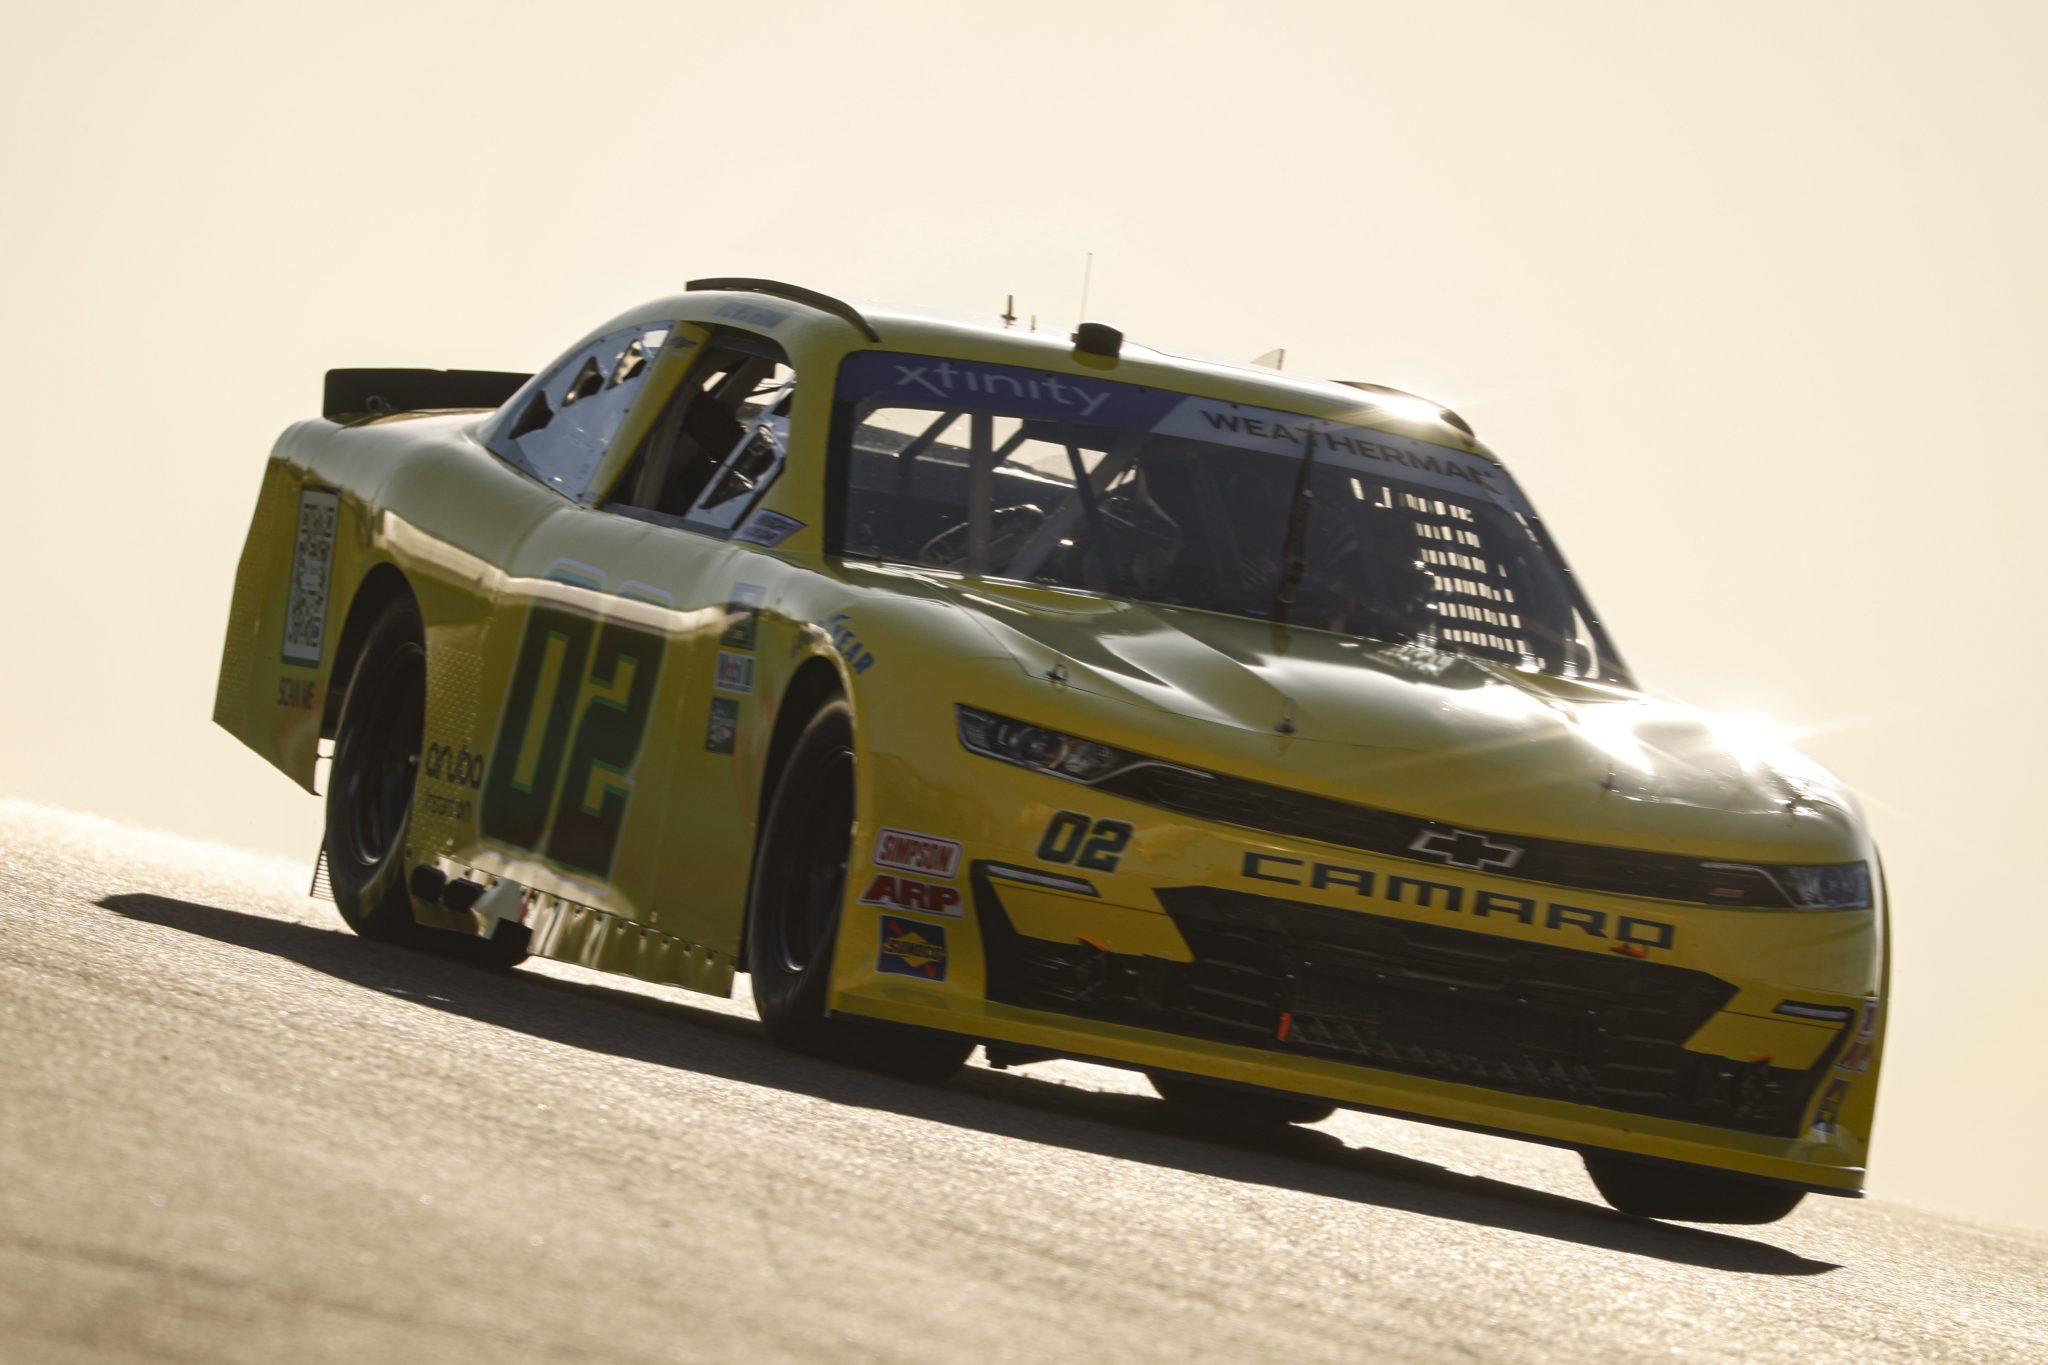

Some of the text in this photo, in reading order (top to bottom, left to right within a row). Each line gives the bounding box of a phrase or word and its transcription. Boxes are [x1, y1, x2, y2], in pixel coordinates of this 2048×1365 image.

[896, 362, 1111, 416] xfinity
[481, 562, 672, 884] 02
[880, 835, 955, 872] SIMPSON
[1037, 810, 1132, 872] 02
[863, 874, 960, 911] ARP
[1242, 852, 1675, 949] CAMARO
